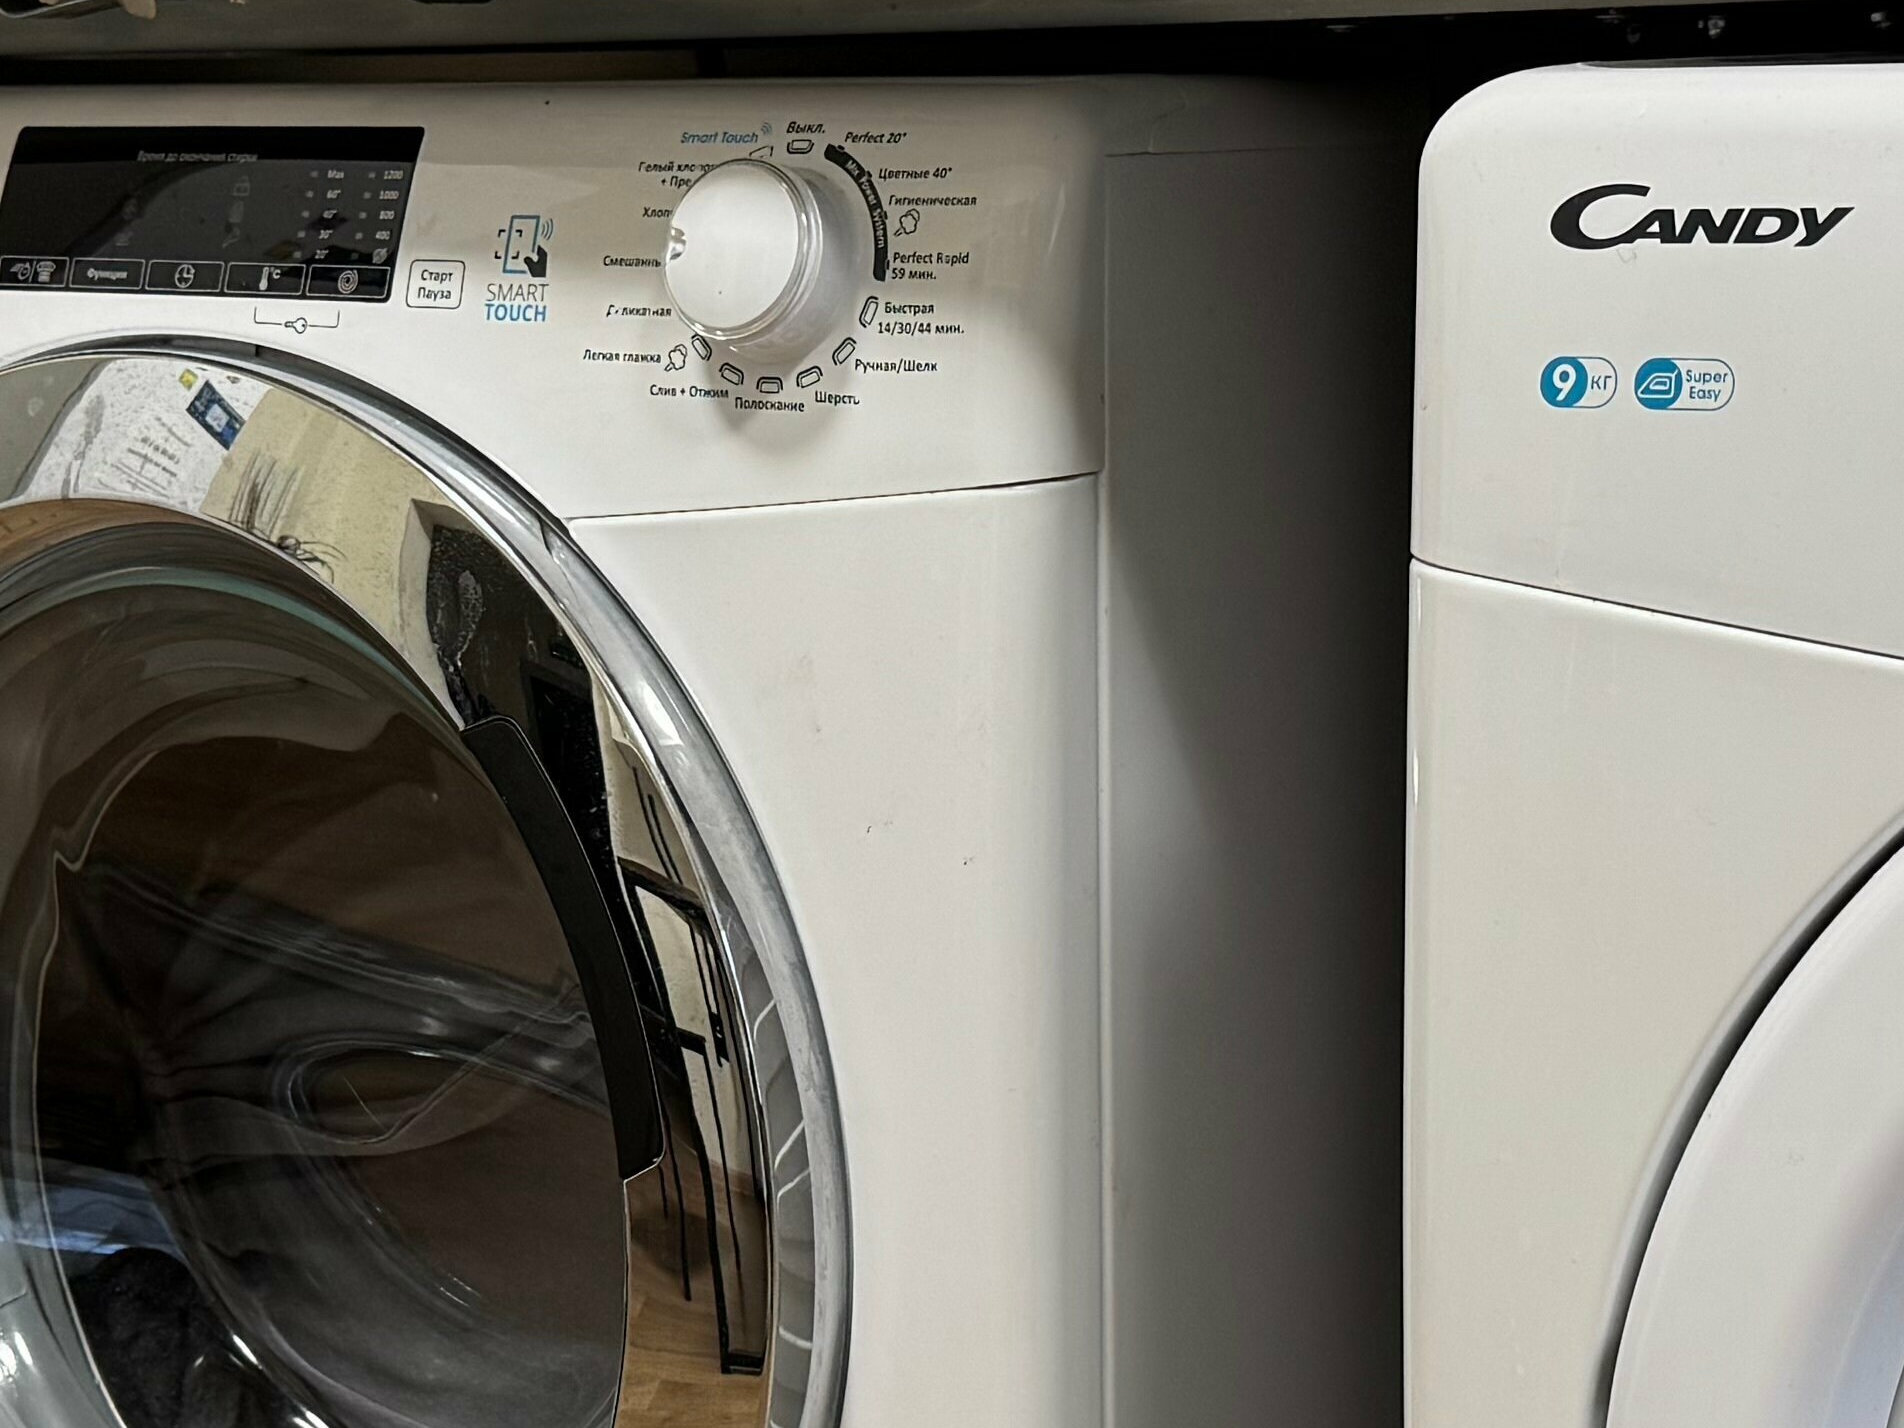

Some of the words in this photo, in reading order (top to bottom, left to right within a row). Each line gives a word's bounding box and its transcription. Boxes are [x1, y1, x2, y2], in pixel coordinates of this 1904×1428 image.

[786, 121, 826, 134] Выкл.
[681, 132, 718, 144] Smart
[721, 132, 759, 144] Touch
[845, 132, 884, 144] Perfect
[878, 168, 930, 180] Цветные
[889, 195, 977, 207] Гигиеническая
[643, 207, 673, 218] Хлоп
[1549, 182, 1856, 250] CANDY
[893, 252, 933, 264] Perfect
[421, 269, 453, 284] Старт
[891, 268, 906, 280] 59
[908, 270, 936, 280] мин.
[418, 286, 451, 301] Пауза
[486, 283, 549, 302] SMART
[484, 304, 547, 322] TOUCH
[884, 302, 934, 316] Быстрая
[878, 322, 932, 336] 14/30/44
[935, 324, 964, 335] мин.
[855, 359, 938, 373] Ручная/Шелк
[1685, 369, 1730, 387] Super
[650, 384, 676, 397] Слив
[1690, 385, 1722, 402] Easy
[735, 396, 805, 412] Полоскание
[815, 391, 860, 406] Шерсть
